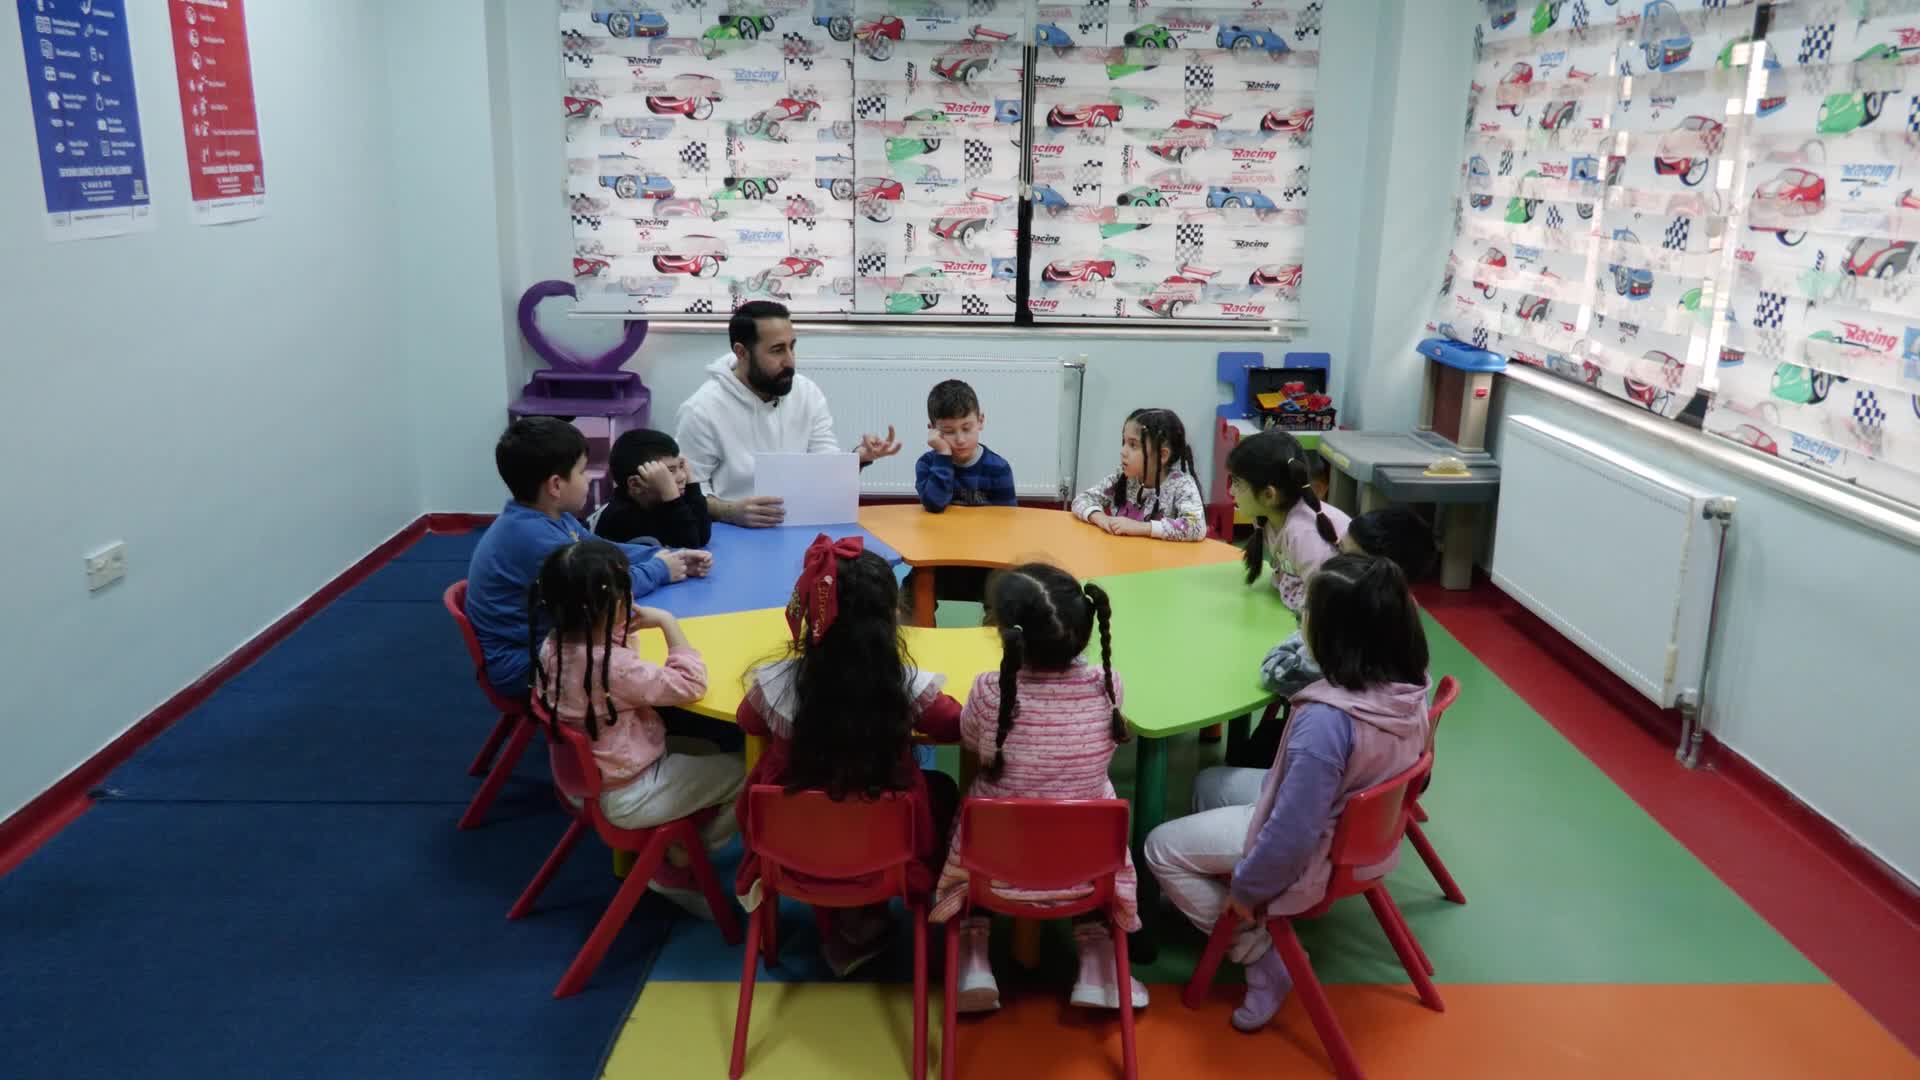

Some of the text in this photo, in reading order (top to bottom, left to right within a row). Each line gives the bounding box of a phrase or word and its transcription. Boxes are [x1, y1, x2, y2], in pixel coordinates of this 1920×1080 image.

[940, 102, 991, 114] Racing
[1032, 143, 1064, 154] acing
[1230, 147, 1277, 160] Racing
[938, 260, 988, 272] Racing
[1218, 302, 1264, 313] Racing
[1840, 321, 1898, 353] Racing
